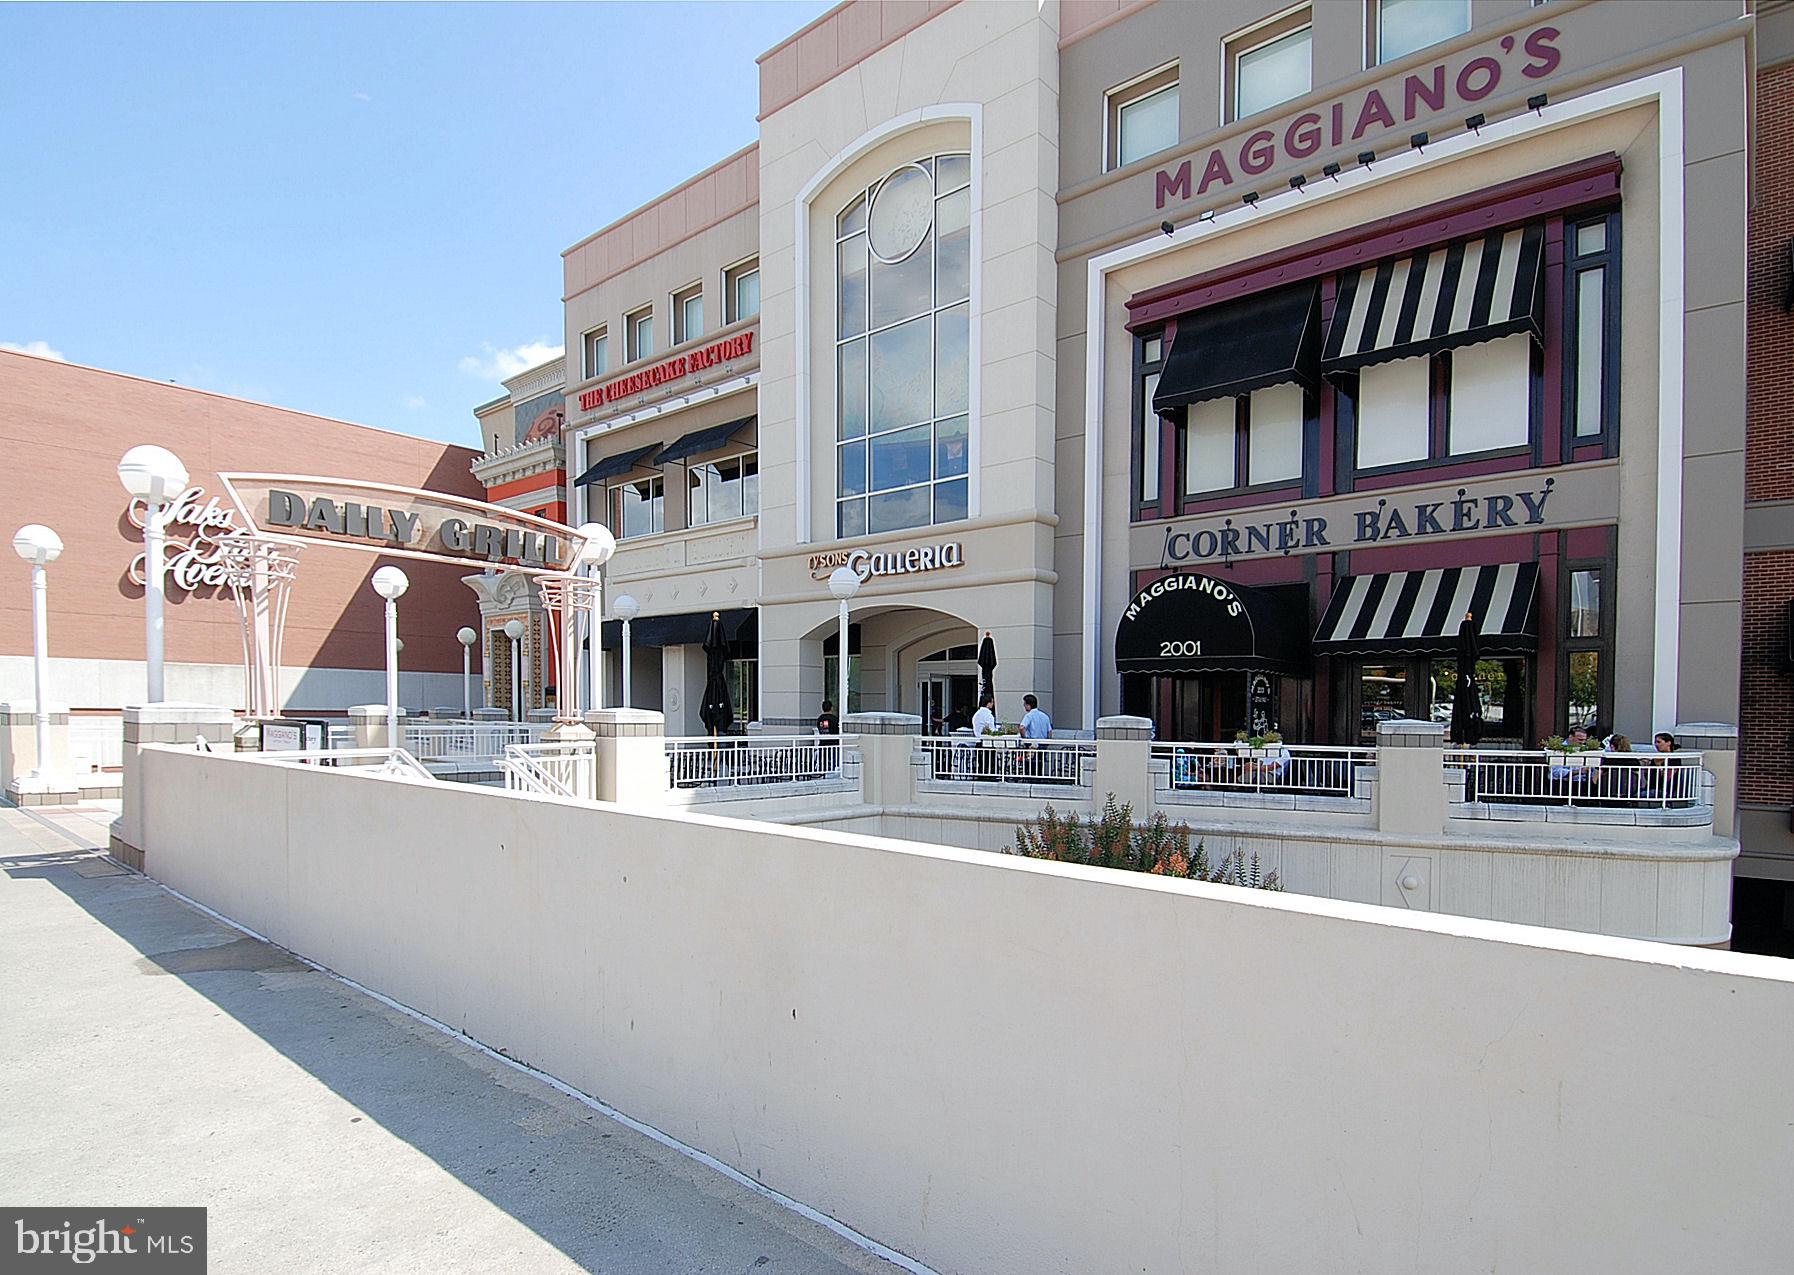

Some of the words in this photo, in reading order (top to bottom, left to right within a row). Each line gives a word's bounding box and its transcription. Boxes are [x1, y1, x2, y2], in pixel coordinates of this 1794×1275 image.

[1154, 26, 1562, 210] MAGGIANO'S
[578, 388, 605, 411] THE
[605, 356, 686, 402] CHEESECAKE
[687, 331, 754, 373] FACTORY
[268, 489, 420, 543] DAILY
[440, 518, 566, 565] GRILL
[1165, 515, 1331, 561] CORNER
[1353, 488, 1553, 542] BAKERY
[1125, 576, 1242, 621] MAGGIANO'S
[1160, 641, 1201, 656] 2001
